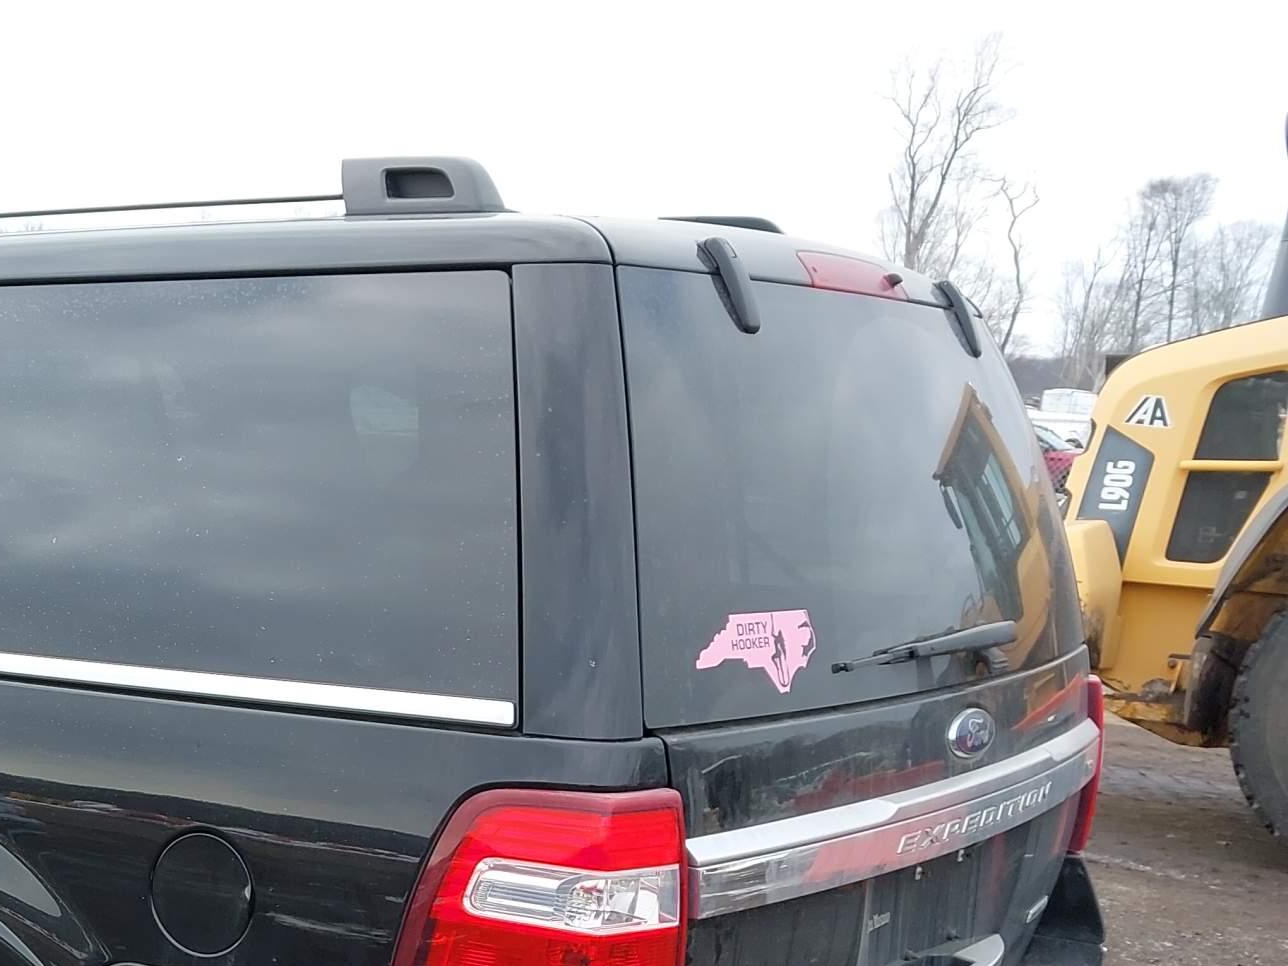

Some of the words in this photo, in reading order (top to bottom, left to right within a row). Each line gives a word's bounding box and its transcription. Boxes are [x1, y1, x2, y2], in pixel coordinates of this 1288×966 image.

[1098, 460, 1136, 511] L90G
[731, 637, 770, 650] HOOKER
[736, 622, 768, 636] DIRTY
[897, 781, 1052, 854] EXPEDITION
